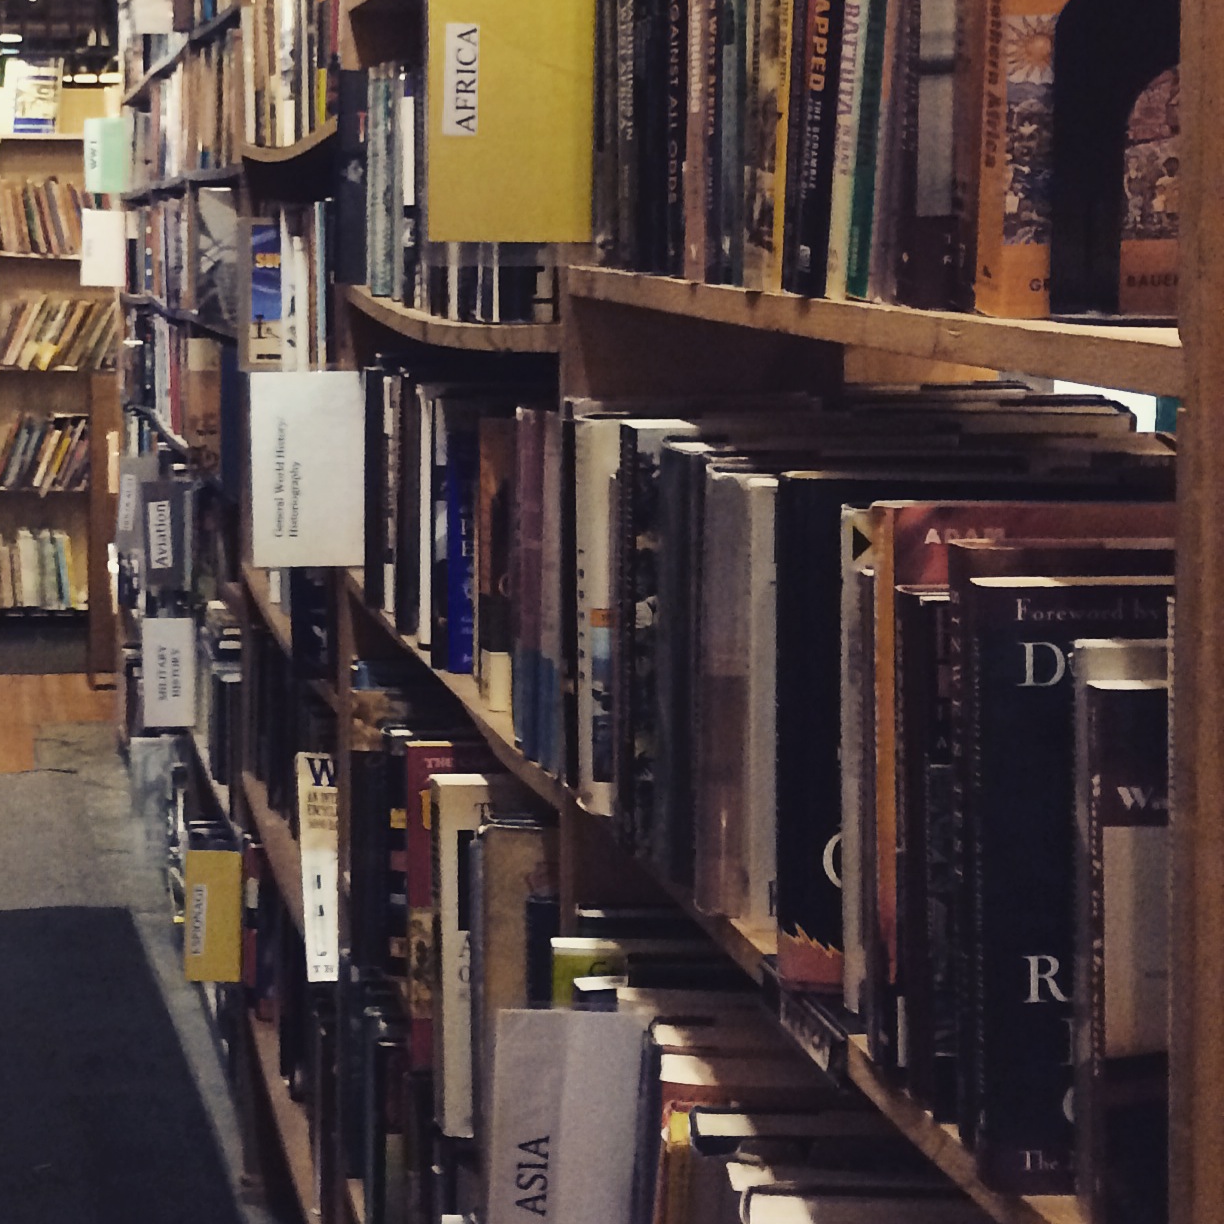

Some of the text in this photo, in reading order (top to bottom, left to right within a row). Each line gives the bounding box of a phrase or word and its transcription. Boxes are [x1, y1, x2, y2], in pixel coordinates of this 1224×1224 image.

[456, 27, 478, 133] AFRICA
[837, 3, 861, 117] BATTUTA
[813, 100, 823, 121] THE
[984, 89, 1002, 168] Africa
[667, 142, 679, 204] ODDS
[273, 460, 285, 494] World
[154, 502, 169, 567] Aviation
[274, 496, 285, 538] General
[1015, 597, 1124, 622] Foreword
[158, 646, 168, 701] MILITARY
[171, 648, 181, 698] HISTORY
[1017, 641, 1075, 687] D
[514, 1134, 550, 1217] ASIA
